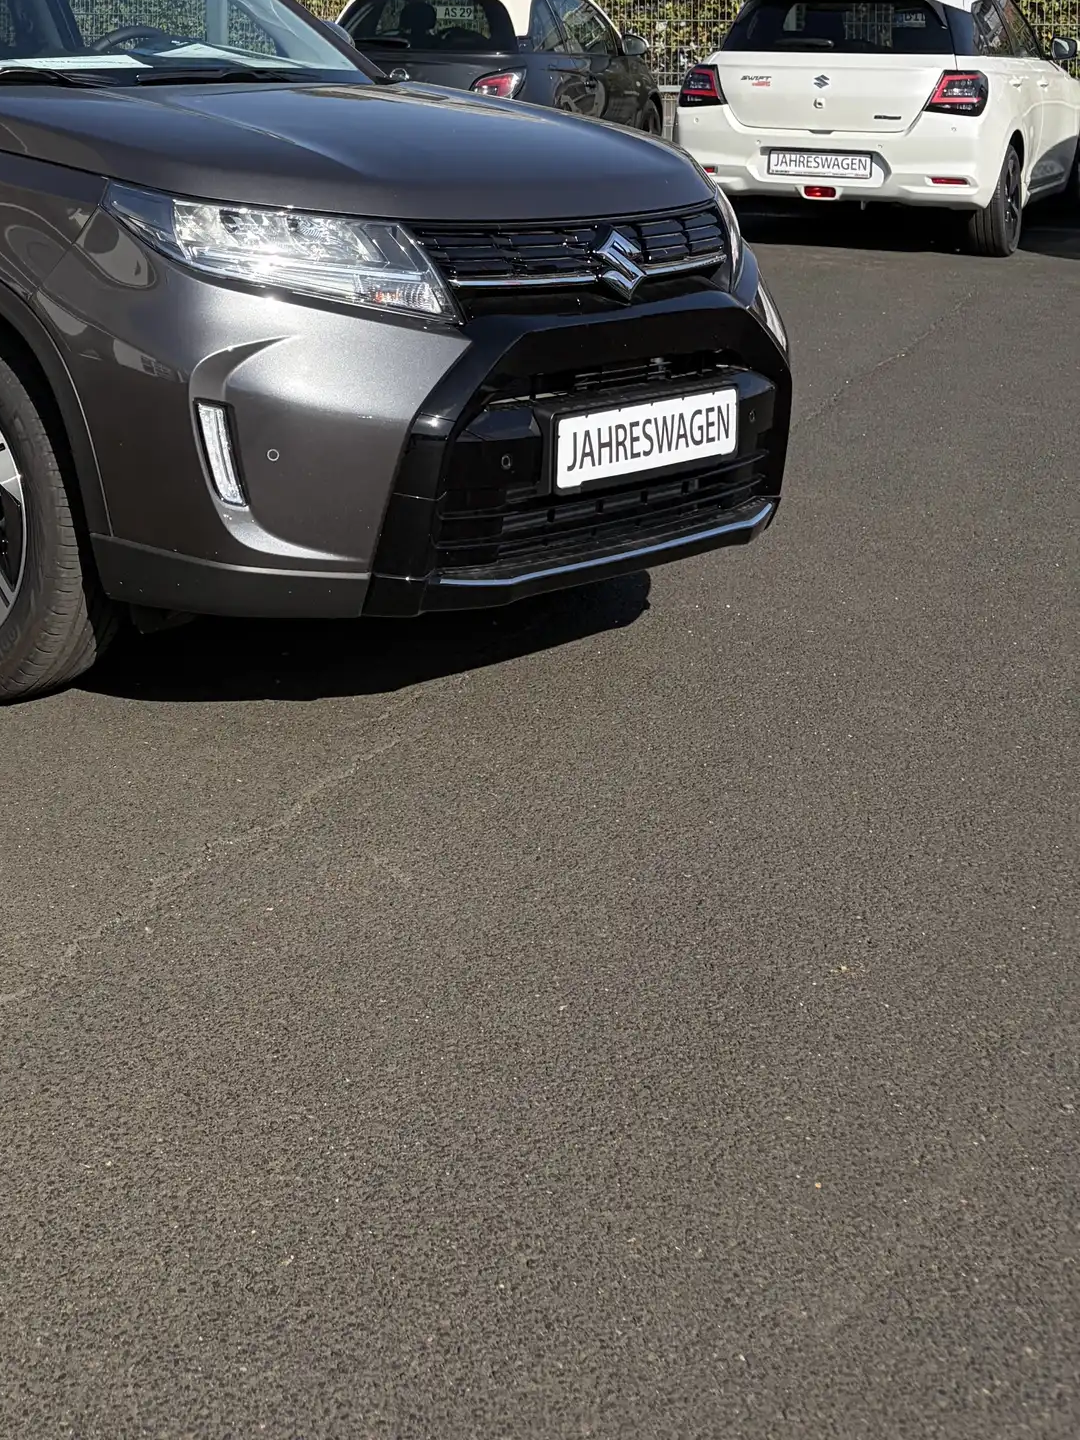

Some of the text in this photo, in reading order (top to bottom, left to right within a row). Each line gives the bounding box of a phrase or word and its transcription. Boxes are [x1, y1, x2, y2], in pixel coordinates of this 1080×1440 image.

[444, 7, 472, 18] AS 29
[774, 153, 868, 172] JAHRESWAGEN
[566, 403, 731, 473] JAHRESWAGEN
